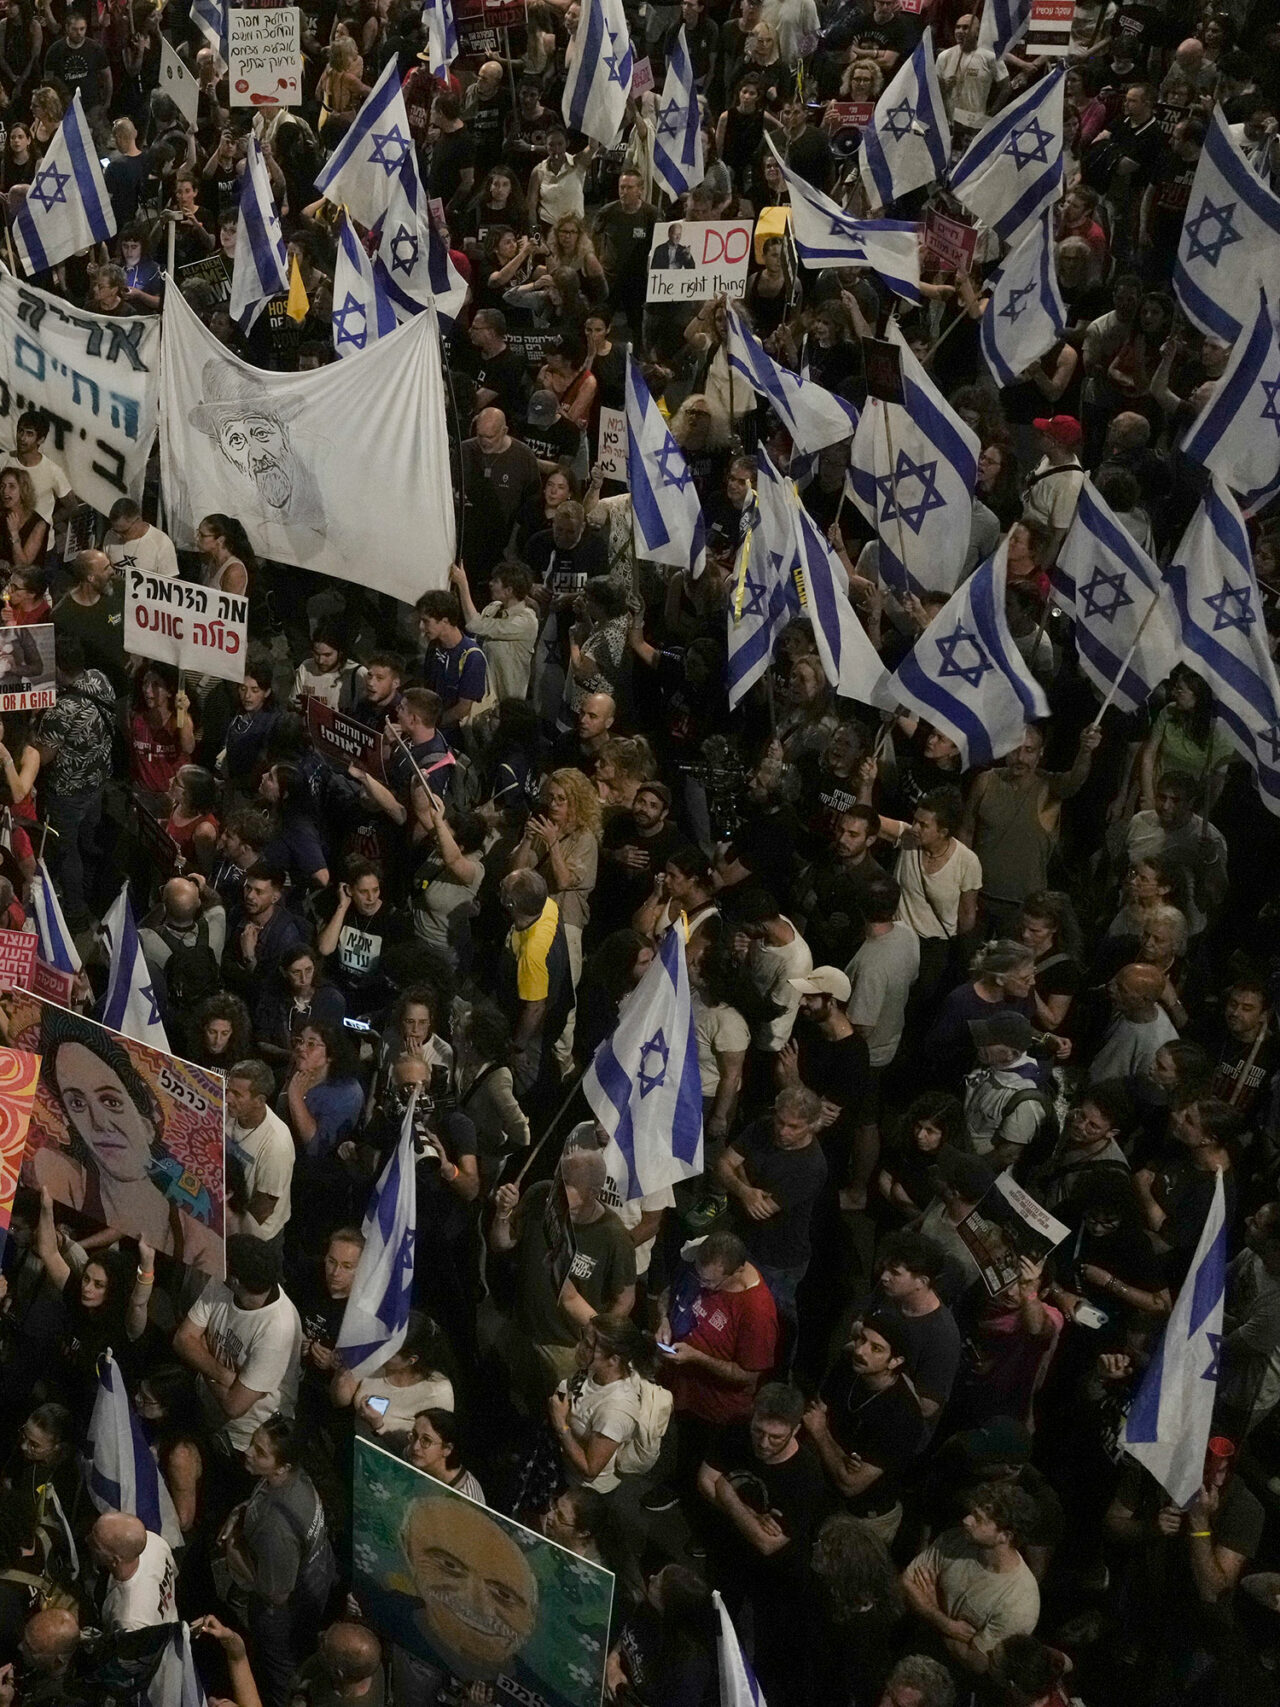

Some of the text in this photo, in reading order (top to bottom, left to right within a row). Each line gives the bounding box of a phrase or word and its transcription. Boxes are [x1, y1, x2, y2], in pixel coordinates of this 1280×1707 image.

[702, 228, 750, 264] DO
[681, 275, 745, 298] right thing
[14, 337, 140, 441] החיים
[218, 595, 247, 624] מה
[192, 619, 240, 654] כולה
[3, 694, 17, 710] OR
[20, 693, 27, 708] A
[30, 691, 55, 708] GIRL
[161, 1069, 206, 1111] כרמל
